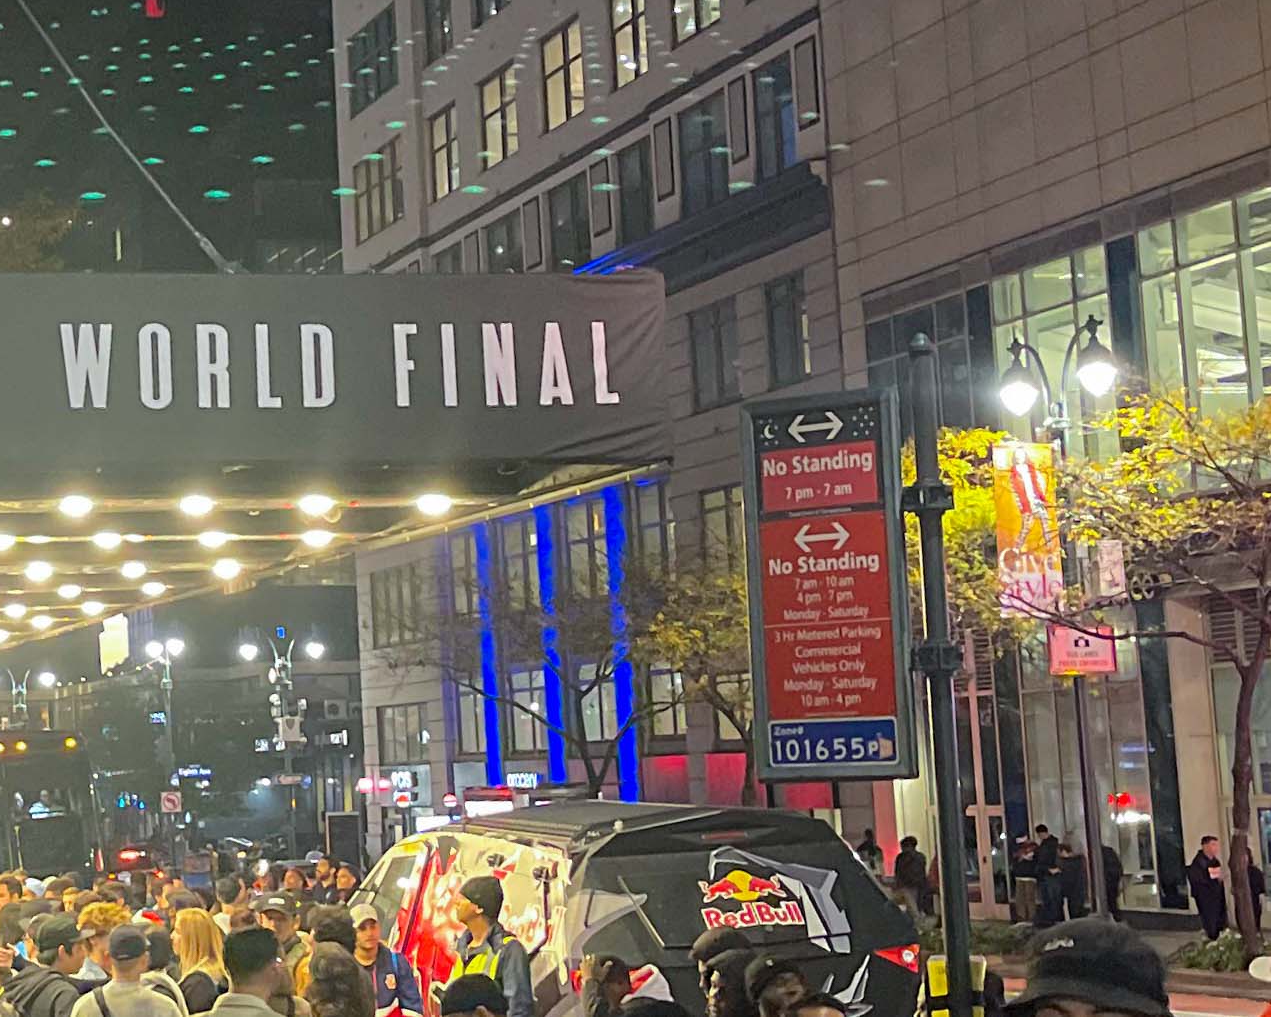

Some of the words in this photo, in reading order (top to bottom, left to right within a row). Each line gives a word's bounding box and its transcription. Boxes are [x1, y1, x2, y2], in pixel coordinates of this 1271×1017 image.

[60, 323, 336, 410] WORLD
[392, 321, 620, 408] FINAL
[763, 458, 788, 477] No
[792, 449, 872, 474] Standing
[785, 486, 792, 500] 7
[795, 486, 814, 502] pm
[824, 483, 831, 496] 7
[834, 483, 852, 496] am
[769, 558, 793, 575] No
[798, 551, 880, 573] Standing
[999, 547, 1058, 574] Give
[803, 579, 818, 590] am
[826, 575, 837, 587] 10
[839, 575, 855, 587] am
[797, 592, 803, 603] 4
[805, 592, 821, 605] pm
[836, 590, 854, 603] pm
[784, 608, 821, 622] Monday
[828, 604, 869, 619] Saturday
[775, 631, 781, 643] 3
[797, 628, 840, 641] Metered
[841, 625, 881, 640] Parking
[795, 642, 861, 659] Commercial
[792, 661, 837, 674] Vehicles
[839, 659, 866, 673] Only
[784, 678, 824, 693] Monday
[832, 675, 877, 690] Saturday
[801, 694, 813, 707] 10
[815, 695, 830, 706] am
[836, 693, 843, 704] 4
[845, 694, 862, 708] pm
[775, 737, 865, 762] 101655
[701, 902, 759, 930] Red
[752, 900, 805, 925] Bull
